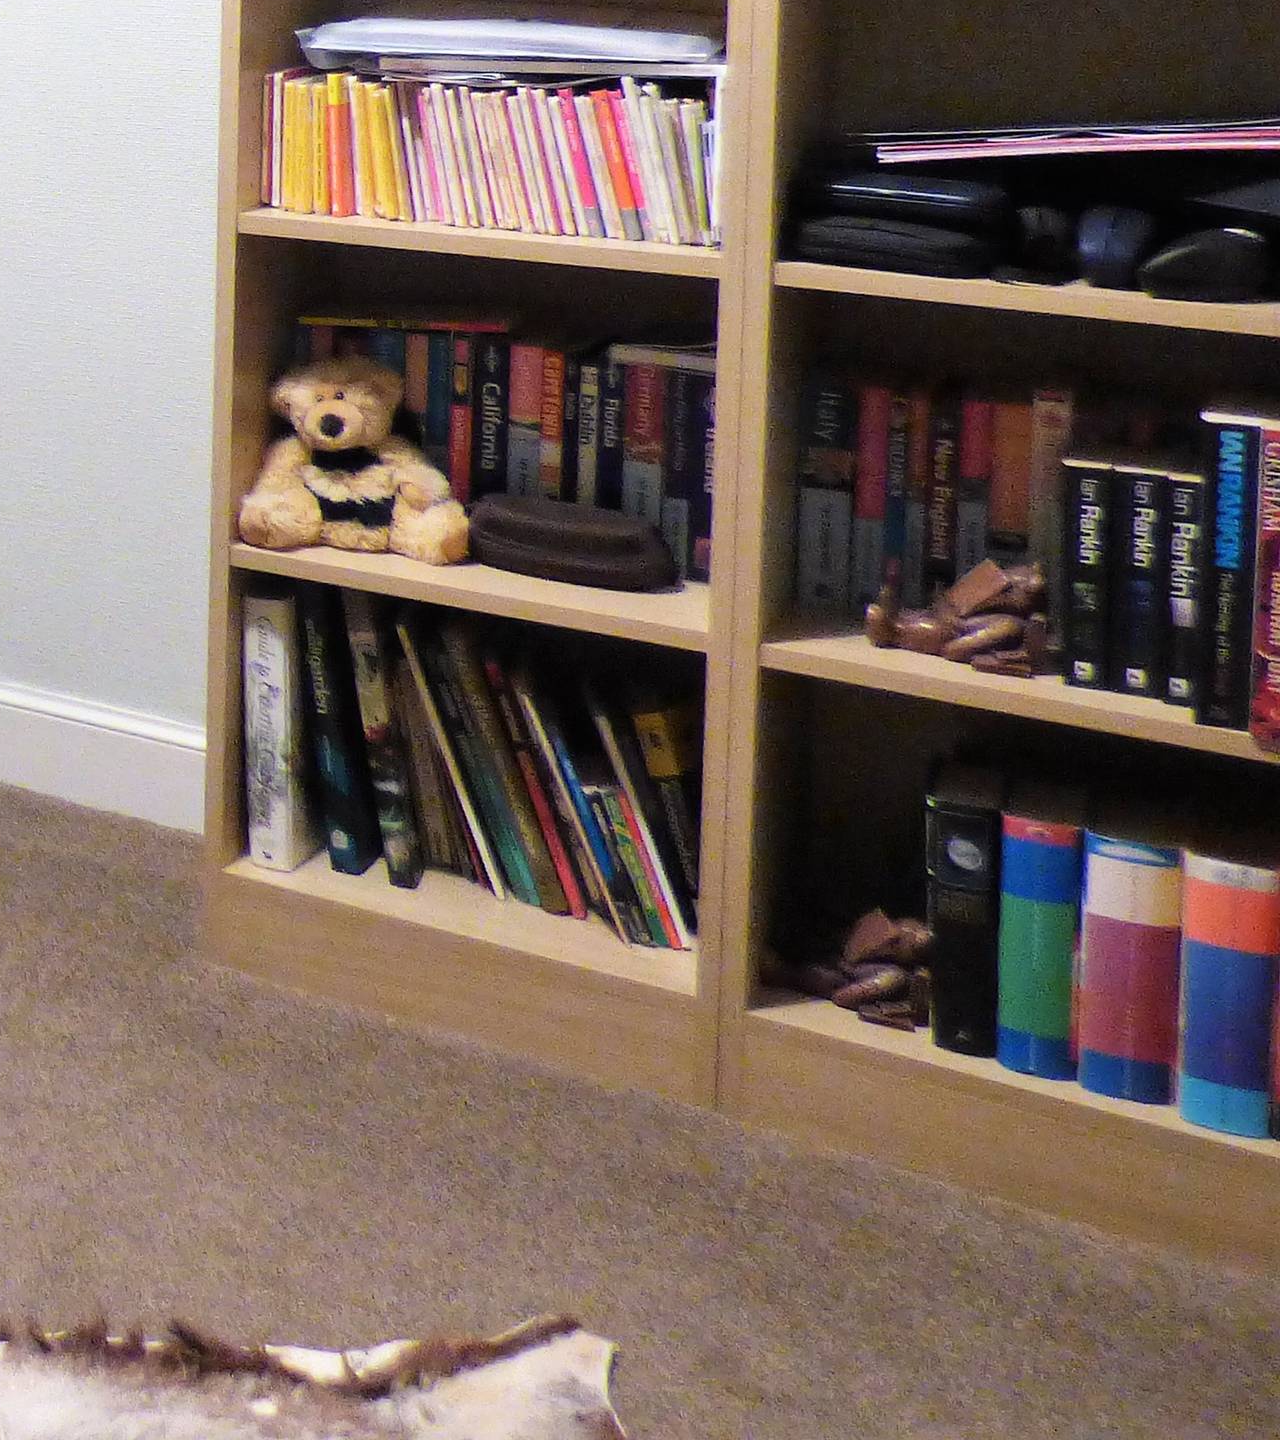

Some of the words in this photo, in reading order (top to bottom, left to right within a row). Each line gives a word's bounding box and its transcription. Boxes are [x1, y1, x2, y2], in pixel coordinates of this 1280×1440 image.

[480, 382, 504, 471] California
[603, 398, 620, 448] Florida
[813, 391, 843, 440] Italy
[1080, 479, 1099, 502] Ian
[1135, 480, 1154, 504] Ian
[1173, 488, 1193, 516] Ian
[1079, 504, 1104, 565] Rankin
[1132, 507, 1158, 568] Rankin
[1170, 521, 1201, 599] Rankin
